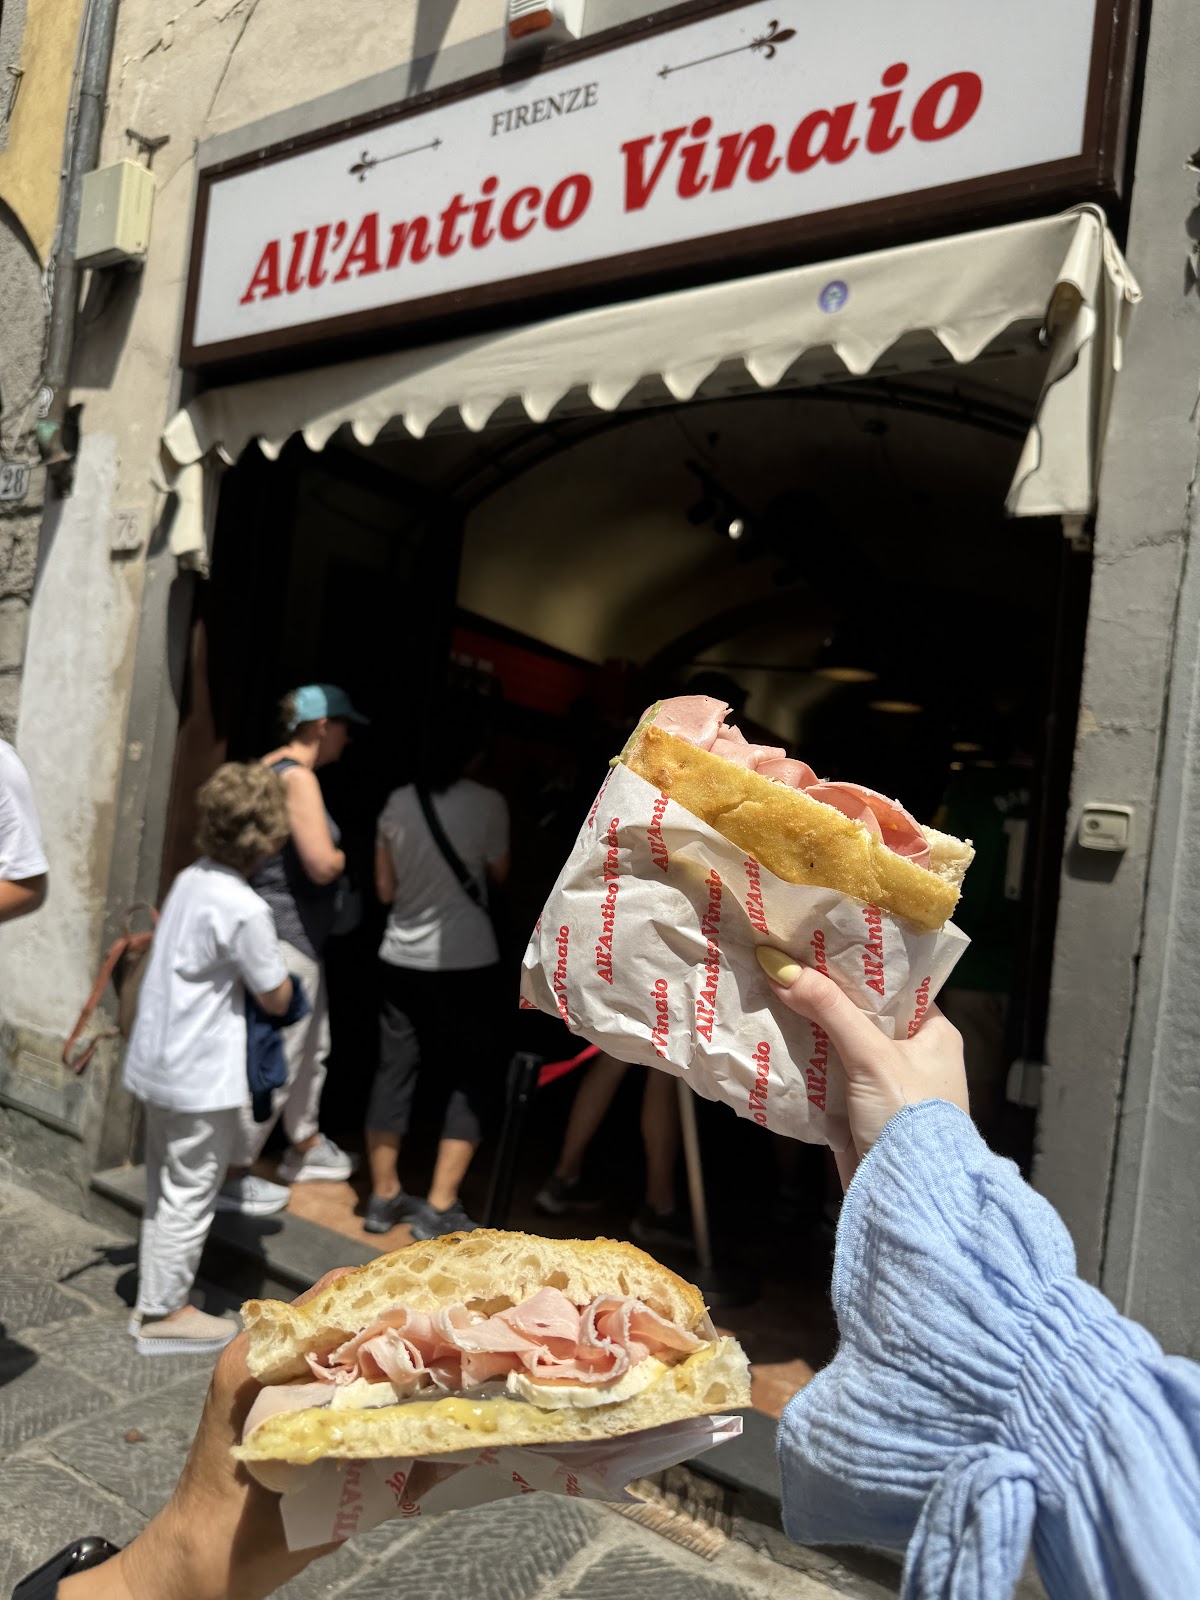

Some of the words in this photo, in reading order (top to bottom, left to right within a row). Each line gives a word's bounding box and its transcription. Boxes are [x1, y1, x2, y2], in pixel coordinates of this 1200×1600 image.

[489, 81, 599, 136] FIRENZE
[239, 172, 593, 304] All'Antico
[621, 62, 983, 212] Vinaio
[809, 929, 830, 979] naio
